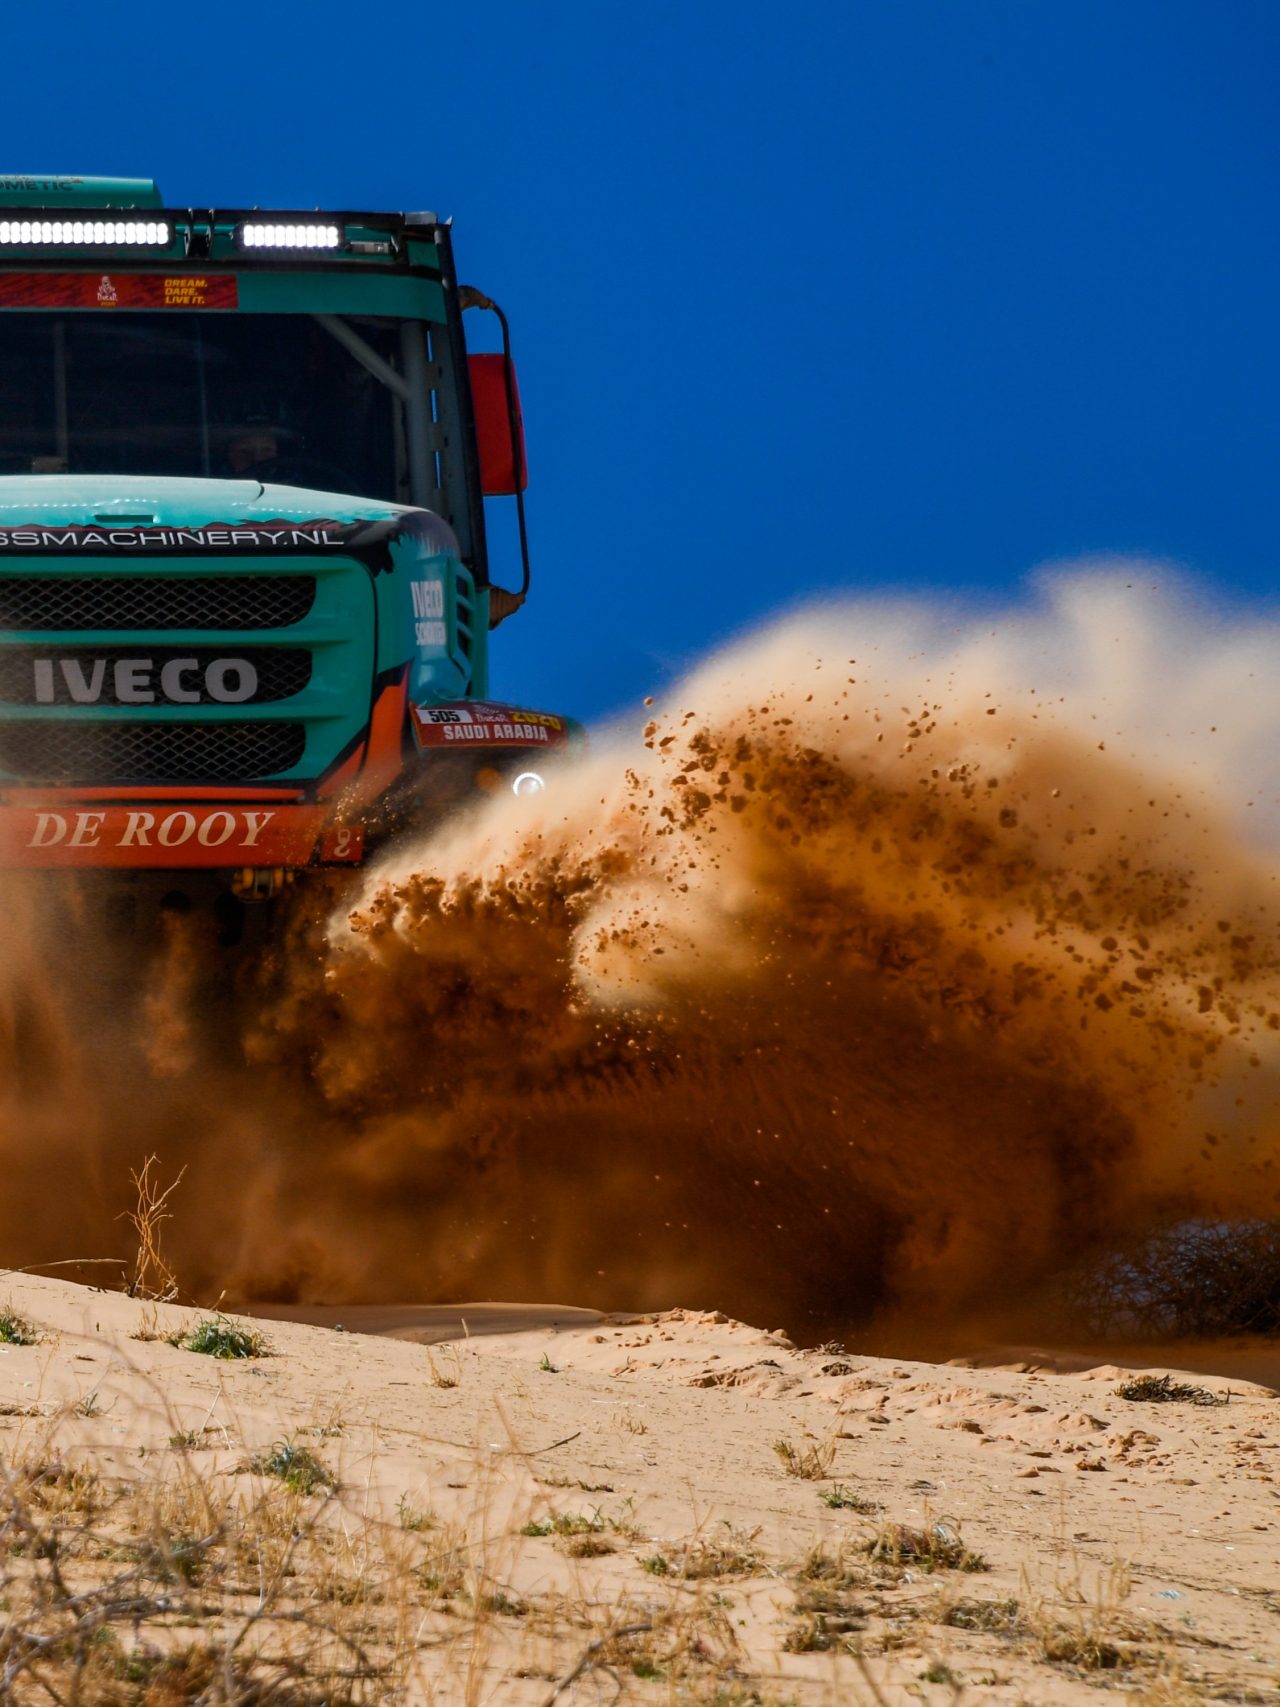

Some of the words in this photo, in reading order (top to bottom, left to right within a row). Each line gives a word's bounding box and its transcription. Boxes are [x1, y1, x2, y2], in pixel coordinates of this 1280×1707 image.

[165, 279, 208, 287] DREAM.
[165, 287, 198, 295] DARE.
[165, 296, 189, 304] LIVE
[192, 296, 205, 304] IT.
[411, 580, 444, 618] IVECO
[34, 657, 258, 703] IVECO
[429, 710, 461, 723] 505
[444, 725, 490, 740] SAUDI
[495, 724, 548, 741] ARABIA
[26, 812, 106, 848] DE
[117, 811, 275, 848] ROOY
